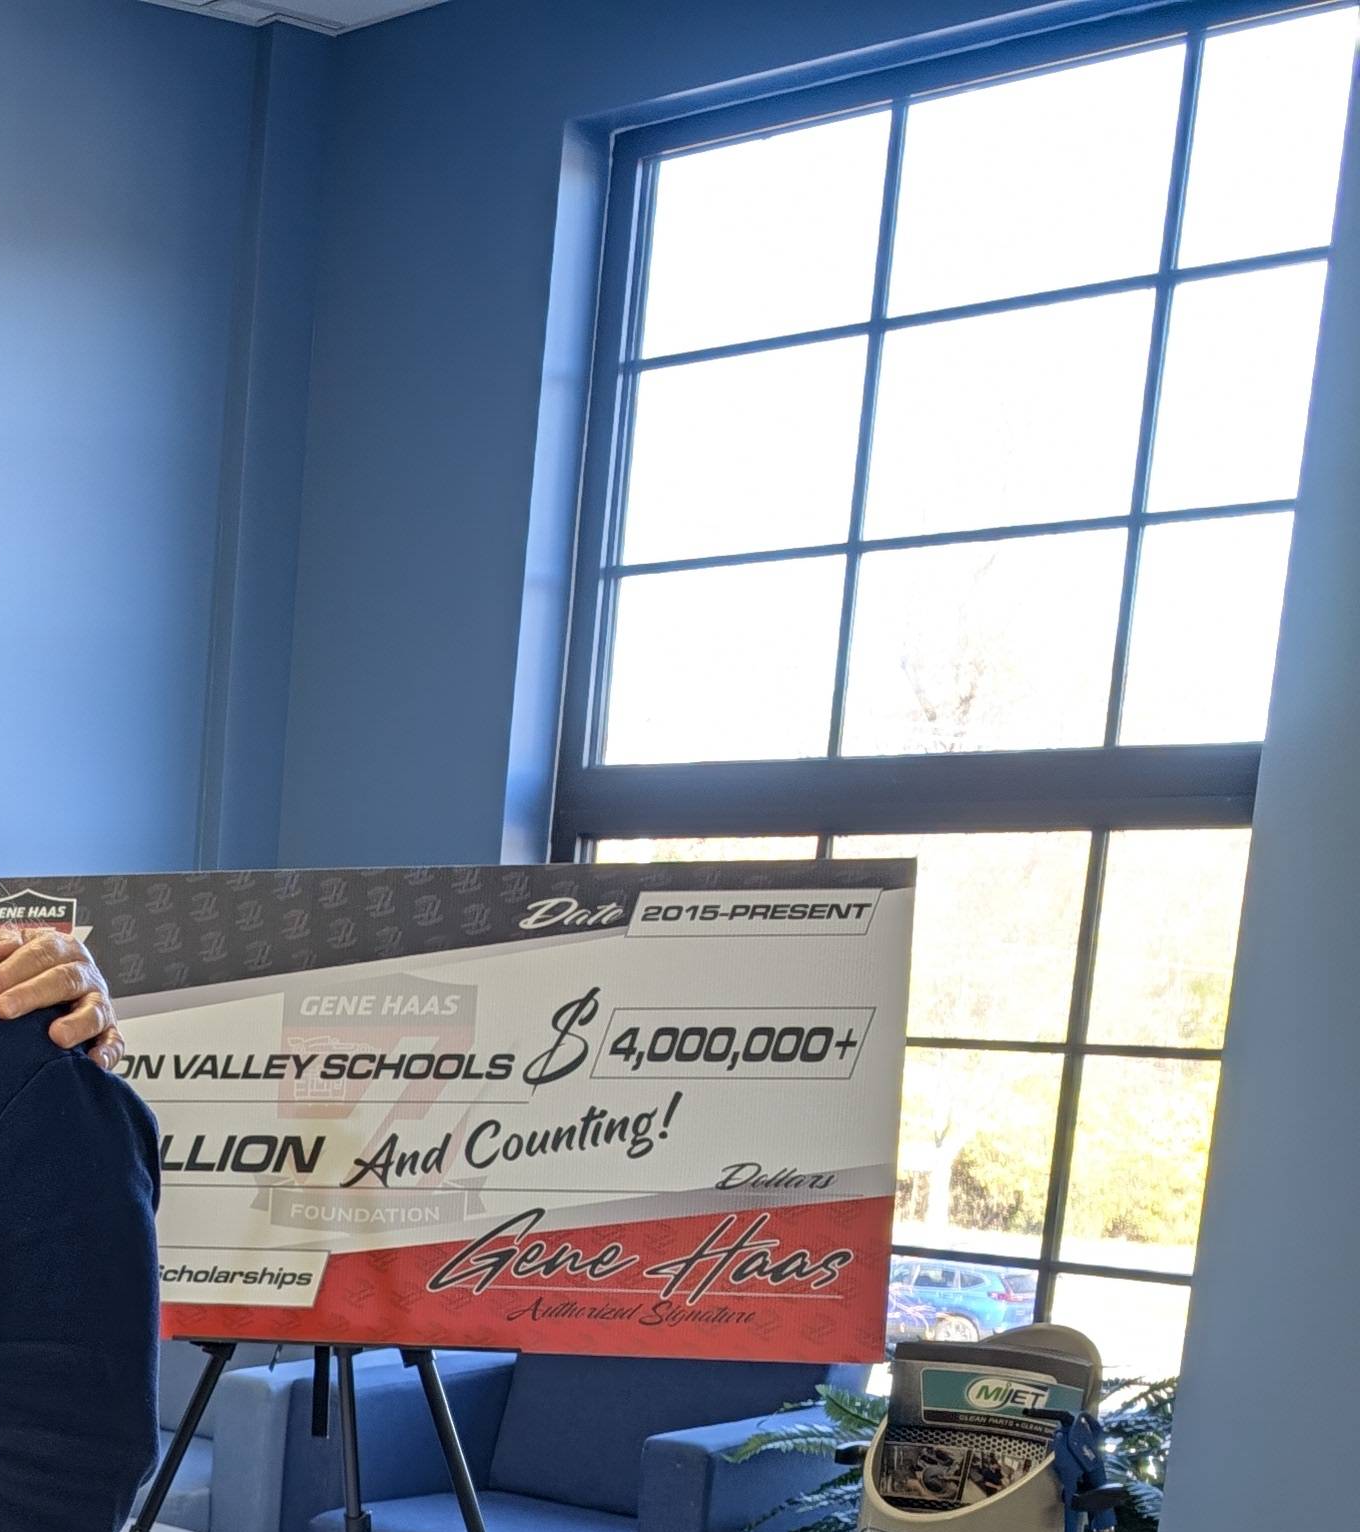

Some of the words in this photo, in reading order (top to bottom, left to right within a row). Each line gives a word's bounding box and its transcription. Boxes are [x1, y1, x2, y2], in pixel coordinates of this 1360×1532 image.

[27, 906, 67, 918] HAAS
[519, 897, 625, 929] Date
[641, 902, 872, 922] 2015-PRESENT
[299, 996, 378, 1016] GENE
[381, 995, 461, 1015] HAAS
[522, 986, 601, 1097] $
[609, 1027, 858, 1071] 4,000,000+
[173, 1054, 320, 1080] VALLEY
[320, 1053, 515, 1080] SCHOOLS
[161, 1135, 326, 1174] LLION
[340, 1132, 452, 1188] And
[464, 1091, 683, 1169] Counting!
[715, 1162, 836, 1190] Dollars
[290, 1204, 440, 1224] FOUNDATION
[426, 1208, 639, 1295] Gene
[644, 1213, 855, 1304] Haas
[507, 1297, 640, 1323] Authorized
[639, 1300, 757, 1326] Signature
[959, 1414, 986, 1423] CLEAN
[988, 1417, 1013, 1427] PARTS
